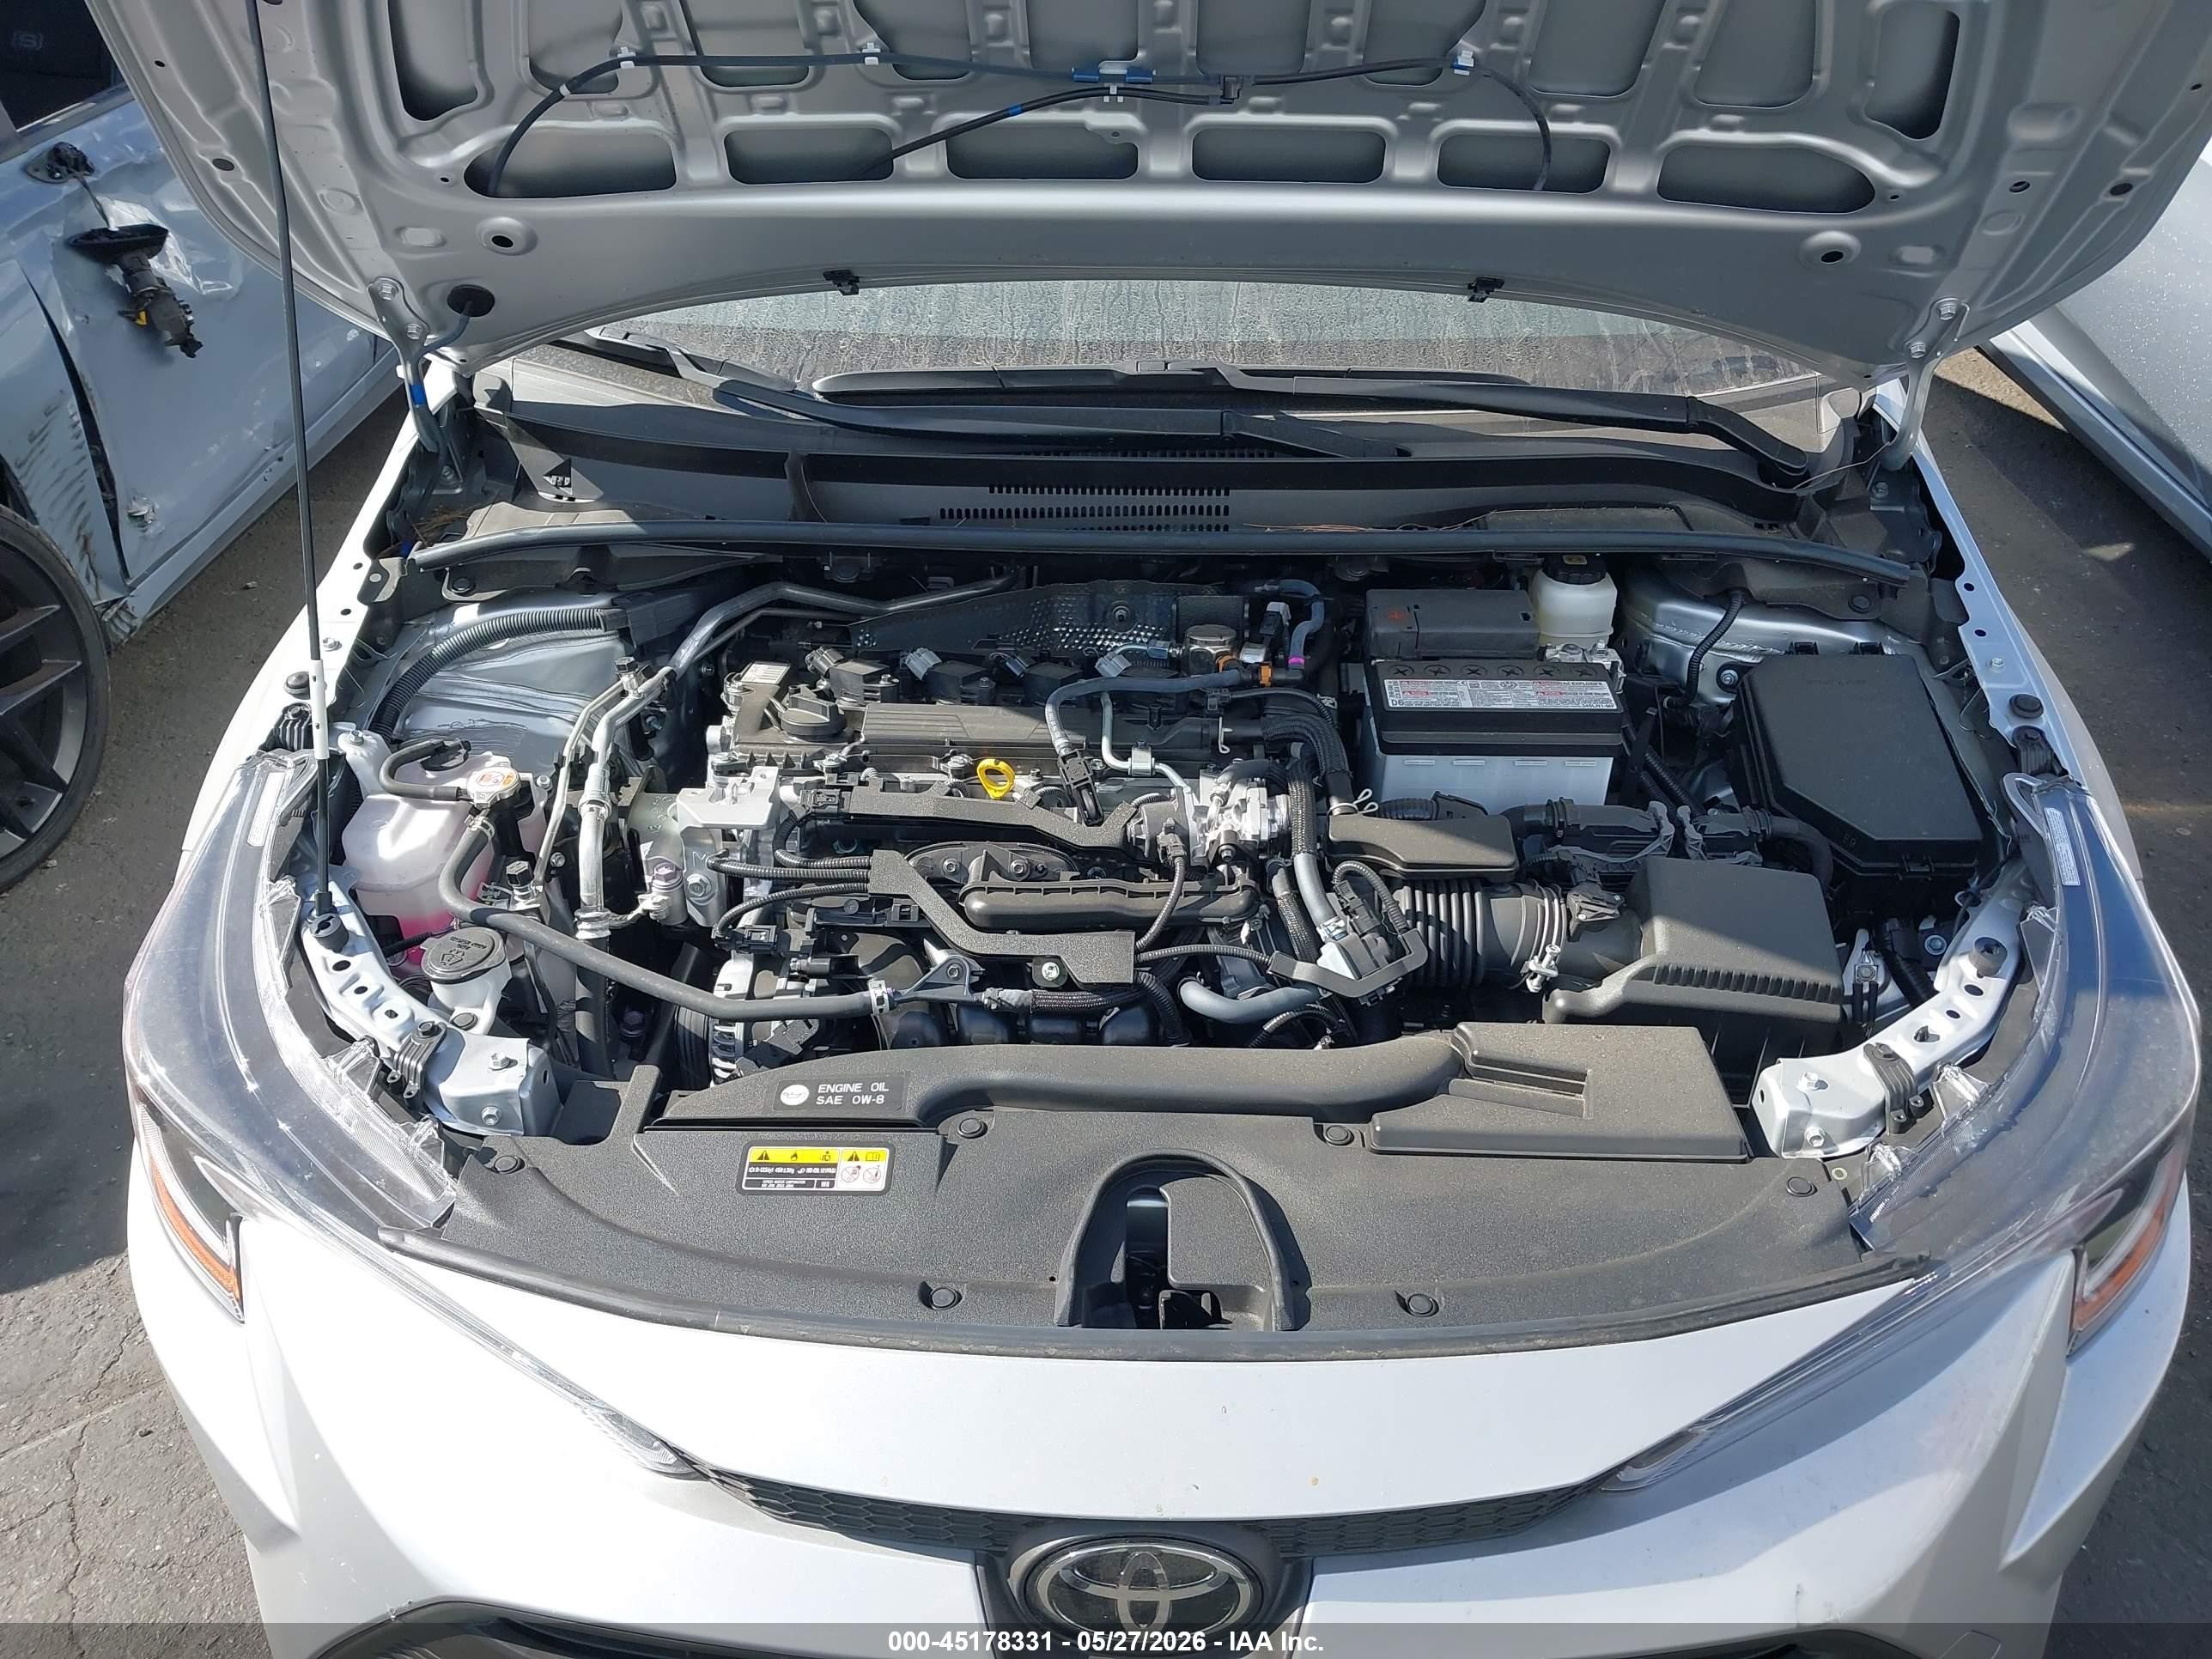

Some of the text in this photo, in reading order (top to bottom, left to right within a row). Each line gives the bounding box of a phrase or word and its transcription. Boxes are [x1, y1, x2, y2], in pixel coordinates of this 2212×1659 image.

[817, 1082, 890, 1093] ENGINE OIL
[816, 1095, 843, 1105] SAE
